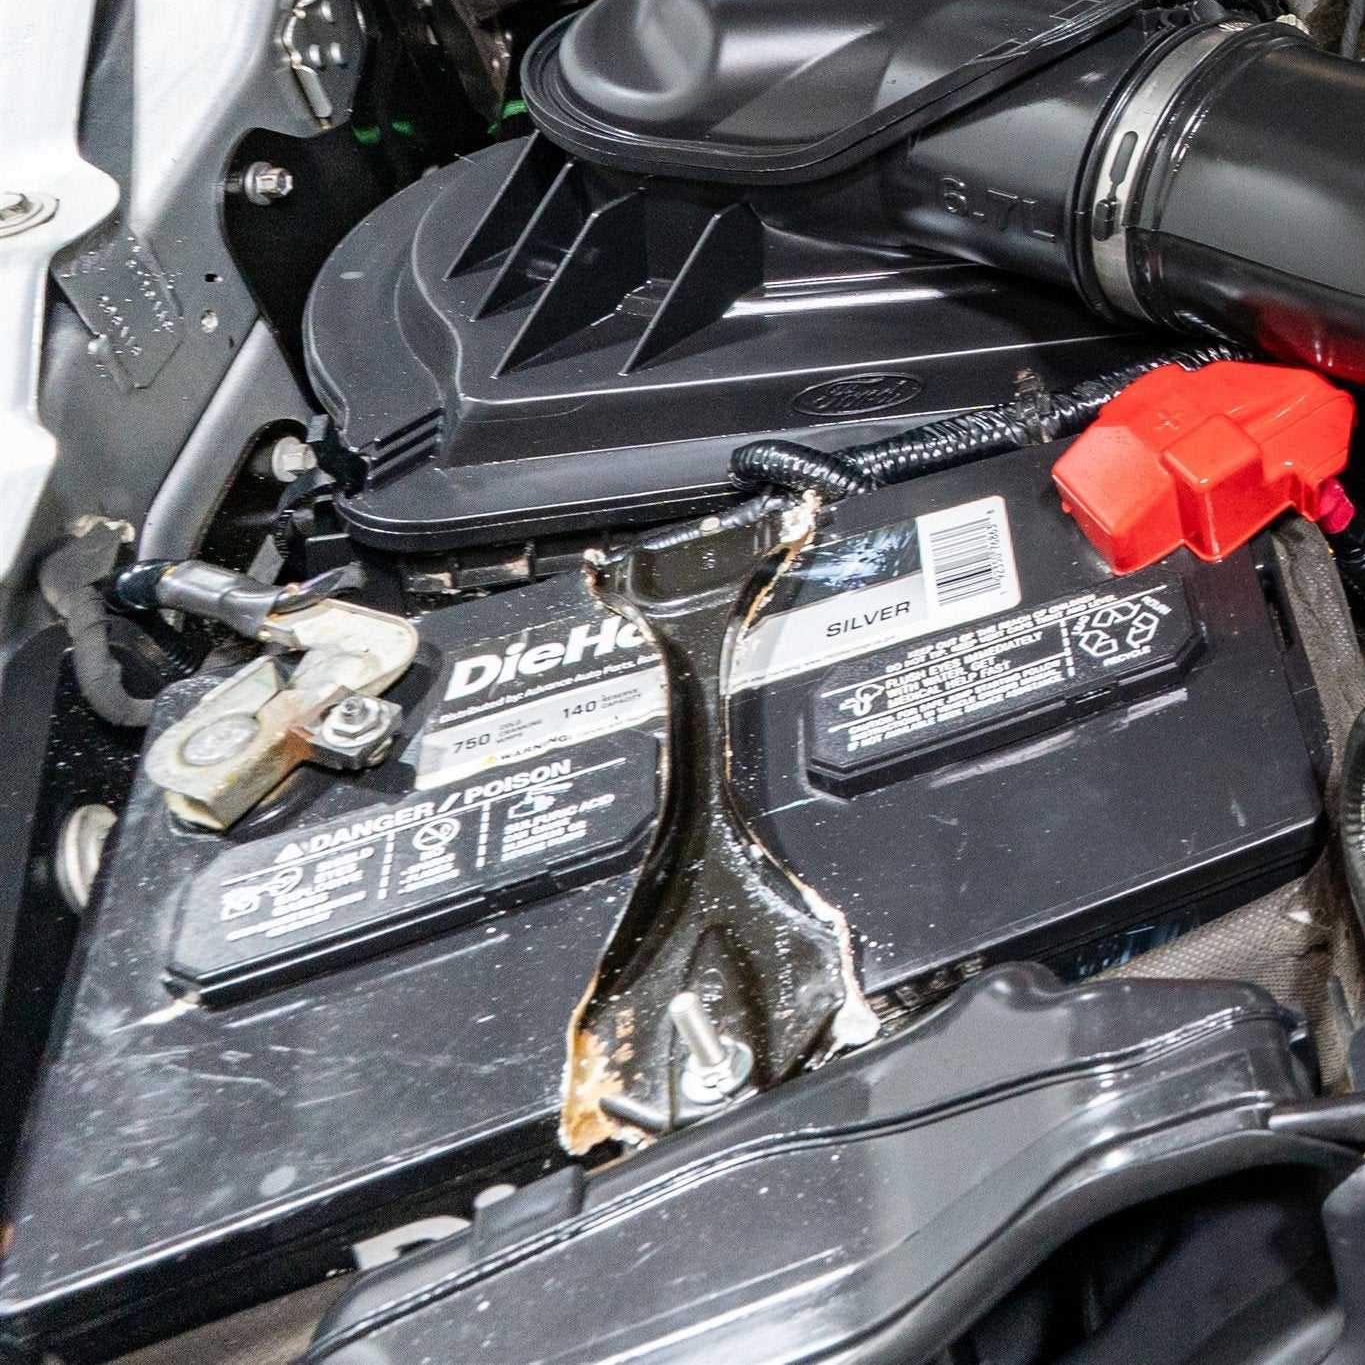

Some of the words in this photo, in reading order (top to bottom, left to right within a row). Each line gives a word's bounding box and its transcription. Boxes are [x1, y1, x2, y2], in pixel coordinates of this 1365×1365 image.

[826, 600, 910, 637] SILVER
[885, 668, 927, 690] FLUSH
[928, 658, 962, 676] EYES
[964, 631, 1043, 665] IMMEDIATELY
[970, 655, 996, 671] GET
[887, 685, 943, 709] MEDICAL
[945, 673, 978, 691] HELP
[979, 658, 1012, 680] FAST
[562, 700, 597, 719] 140
[453, 732, 491, 754] 750
[309, 802, 436, 855] DANGER
[463, 758, 572, 804] POISON
[578, 793, 616, 813] ACID
